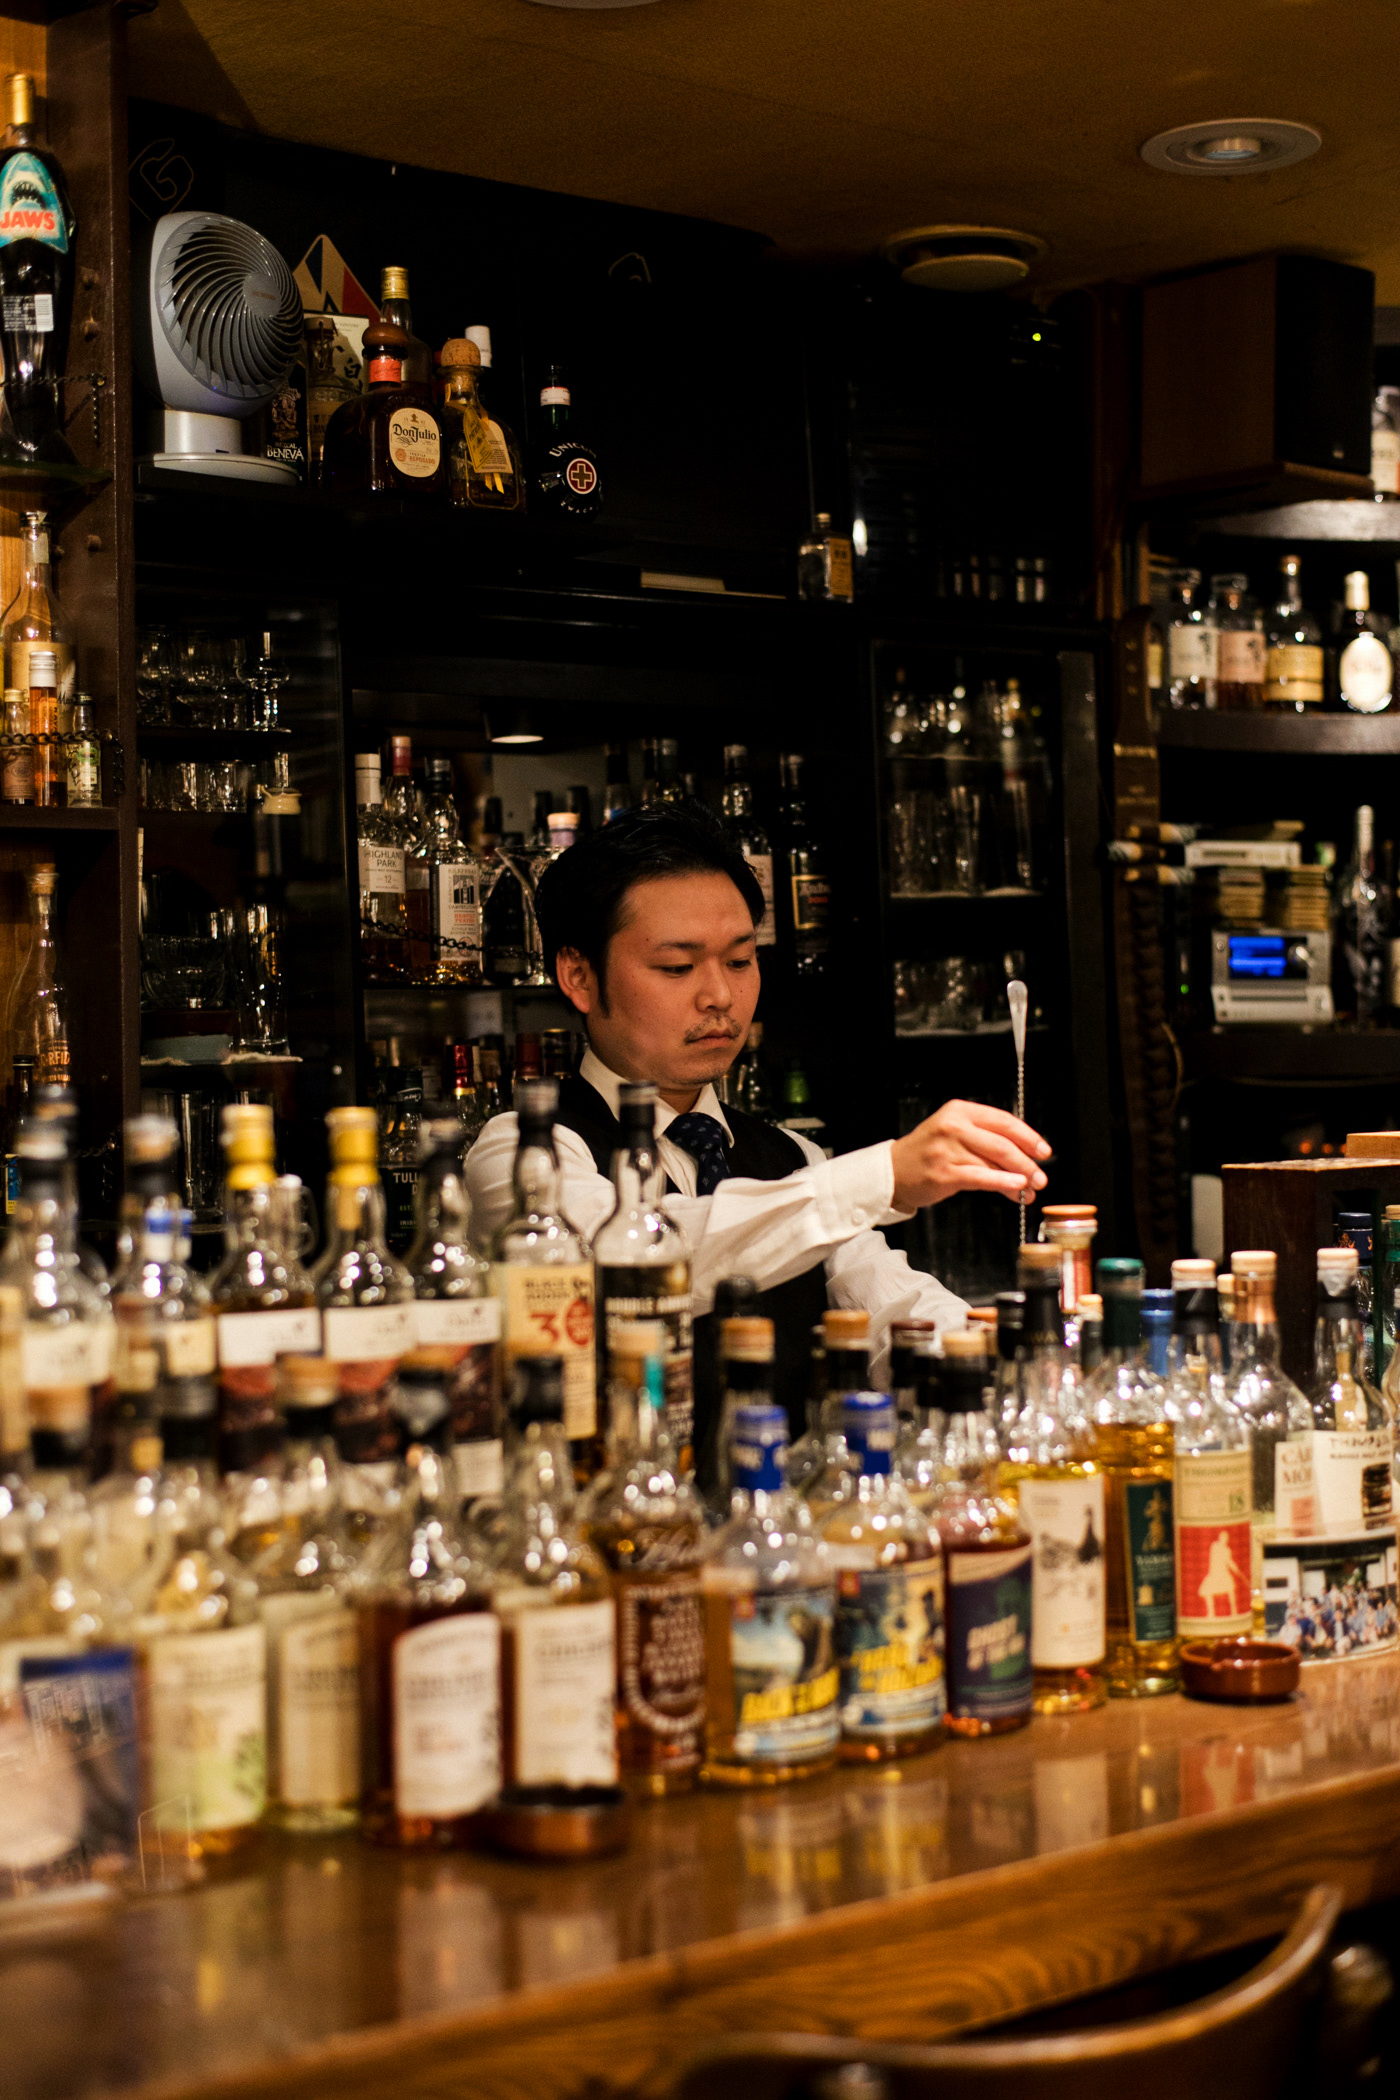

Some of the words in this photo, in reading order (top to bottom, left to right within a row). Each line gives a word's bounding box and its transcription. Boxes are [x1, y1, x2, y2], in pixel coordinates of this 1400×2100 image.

[0, 210, 55, 231] JAWS
[363, 849, 403, 860] HIGHLAND
[377, 859, 397, 868] PARK
[384, 875, 392, 883] 12
[393, 1172, 418, 1184] TULL
